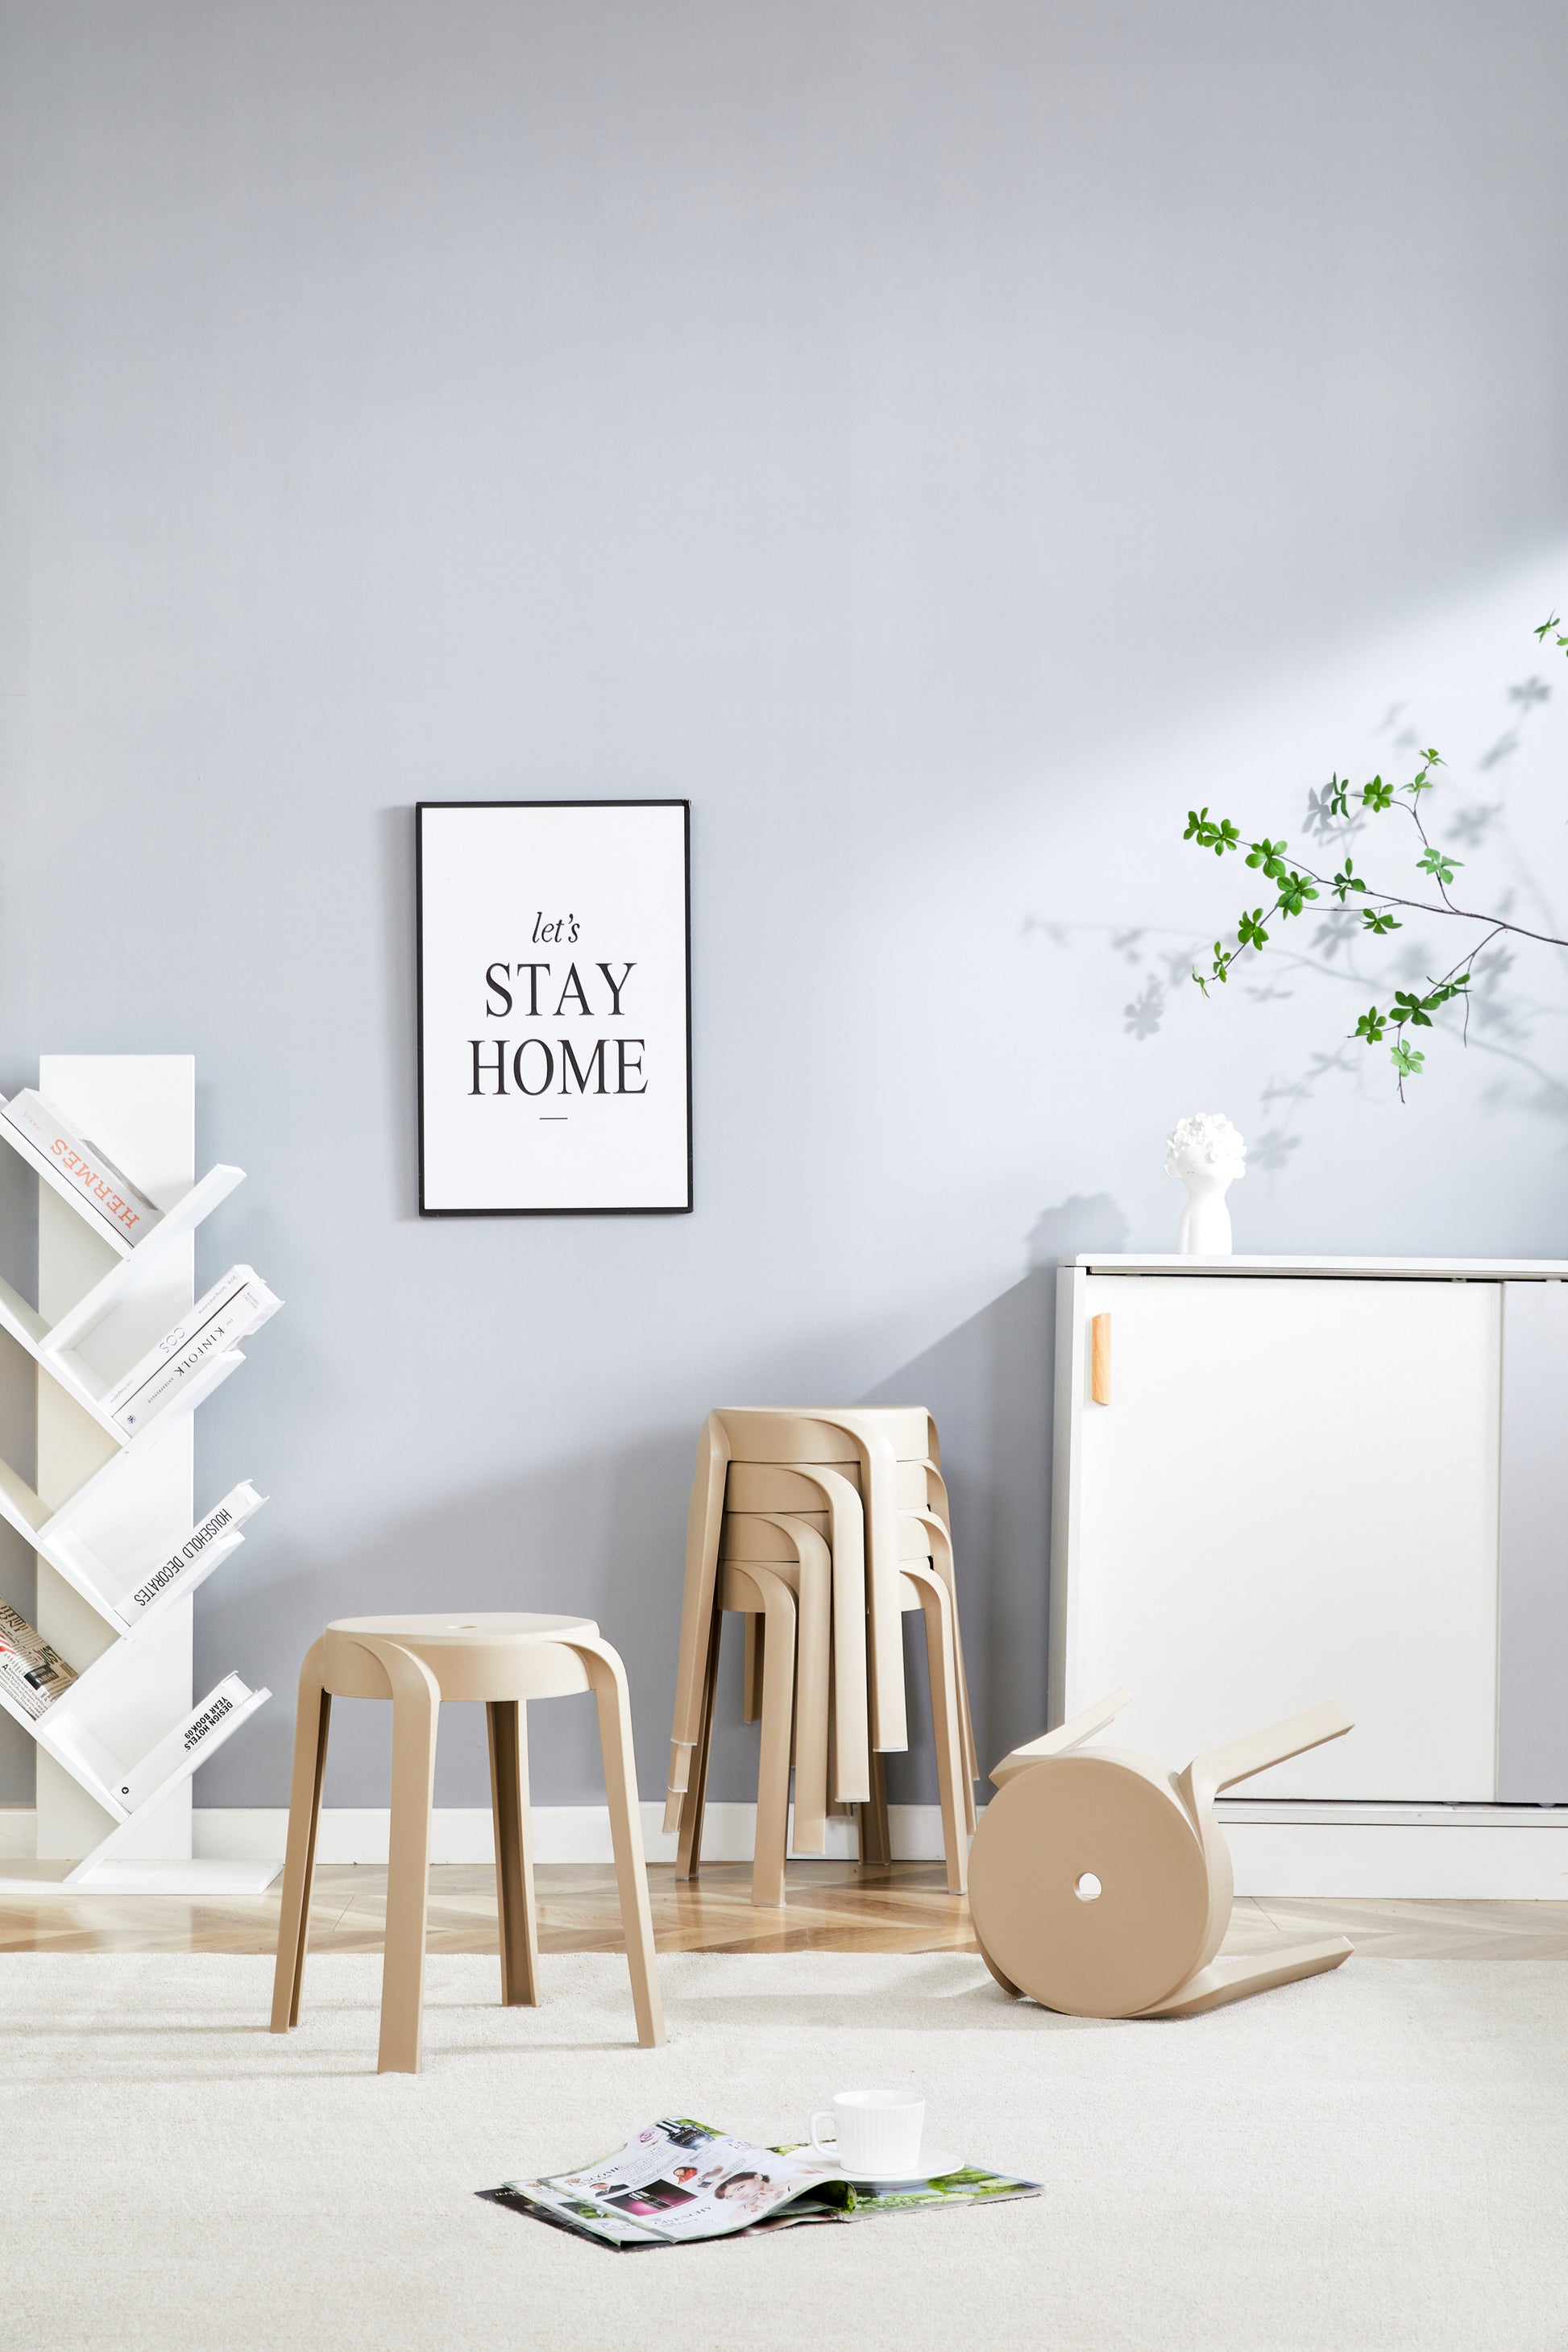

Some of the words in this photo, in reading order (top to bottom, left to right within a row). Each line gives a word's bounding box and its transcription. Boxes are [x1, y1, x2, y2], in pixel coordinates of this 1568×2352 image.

[485, 961, 637, 1018] STAY
[467, 1038, 649, 1097] HOME
[23, 1112, 42, 1130] PARIS
[159, 1327, 185, 1353] COS
[173, 1326, 225, 1377] KINFOLK
[181, 1508, 233, 1559] HOUSEHOLD
[134, 1555, 185, 1607] DECORATES
[208, 1695, 229, 1715] YEAR
[208, 1701, 234, 1727] DESIGN
